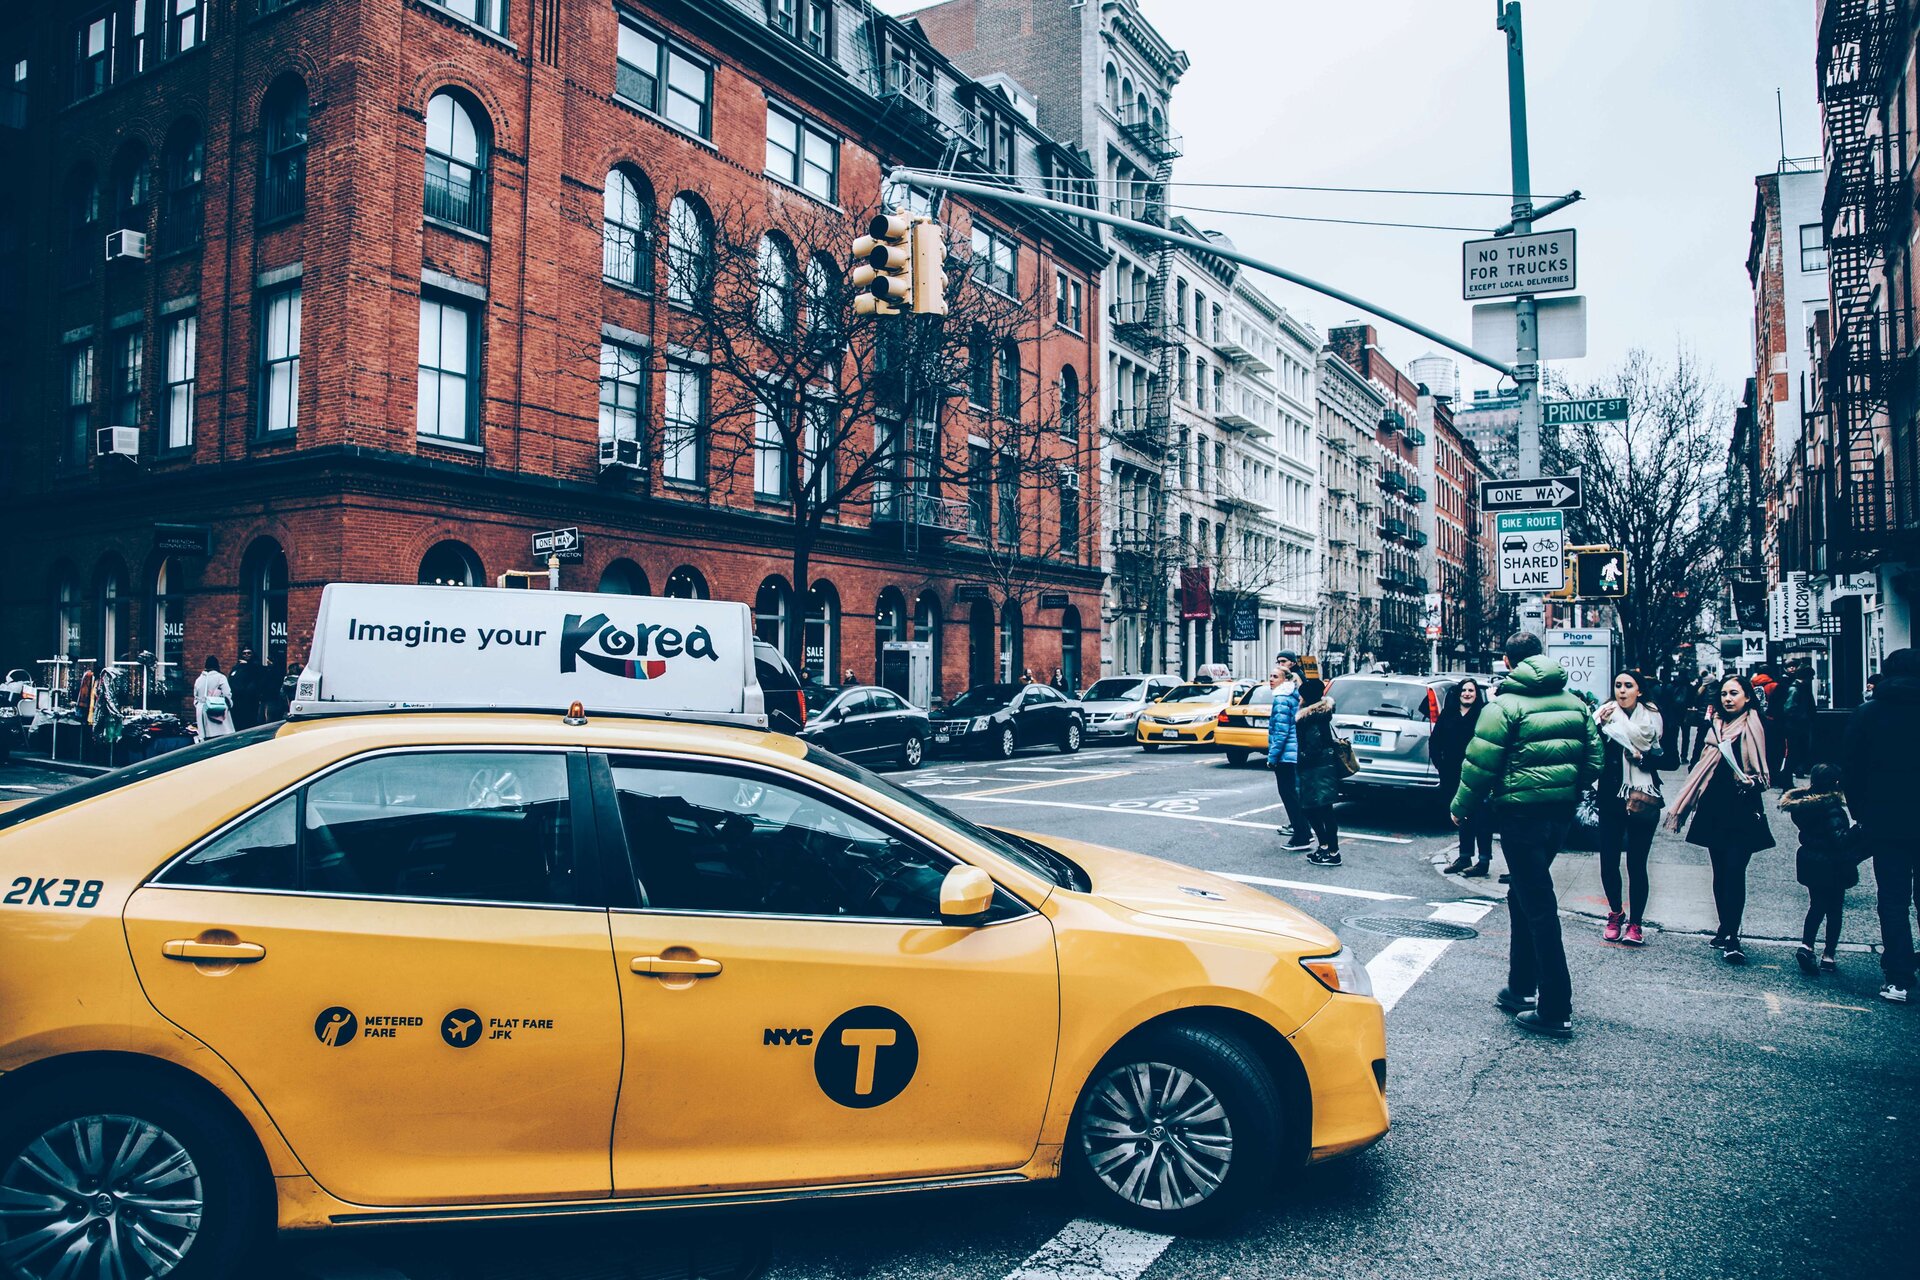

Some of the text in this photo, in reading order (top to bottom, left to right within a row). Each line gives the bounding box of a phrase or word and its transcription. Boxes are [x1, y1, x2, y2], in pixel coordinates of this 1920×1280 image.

[1479, 242, 1559, 262] NO TURNS
[1470, 258, 1568, 280] FOR TRUCKS
[1469, 275, 1569, 292] EXCEPT LOCAL DELIVERIES
[1548, 400, 1621, 422] PRINCE ST
[1495, 487, 1565, 502] ONE WAY
[1501, 516, 1557, 529] BIKE ROUTE
[557, 535, 571, 545] WAY
[1503, 556, 1559, 569] SHARED
[1512, 571, 1549, 584] LANE
[67, 627, 80, 640] SAL
[163, 622, 184, 636] SALE
[270, 622, 288, 636] SAL
[348, 613, 719, 680] Imagine your Korea
[1744, 637, 1764, 651] M
[806, 646, 824, 657] SALE
[1559, 656, 1596, 668] GIVE
[2, 876, 104, 908] 2K38
[365, 1016, 423, 1027] METERED
[489, 1018, 553, 1029] FLAT FARE
[364, 1028, 396, 1038] FARE
[489, 1030, 512, 1040] JFK
[763, 1028, 896, 1095] NYC T
